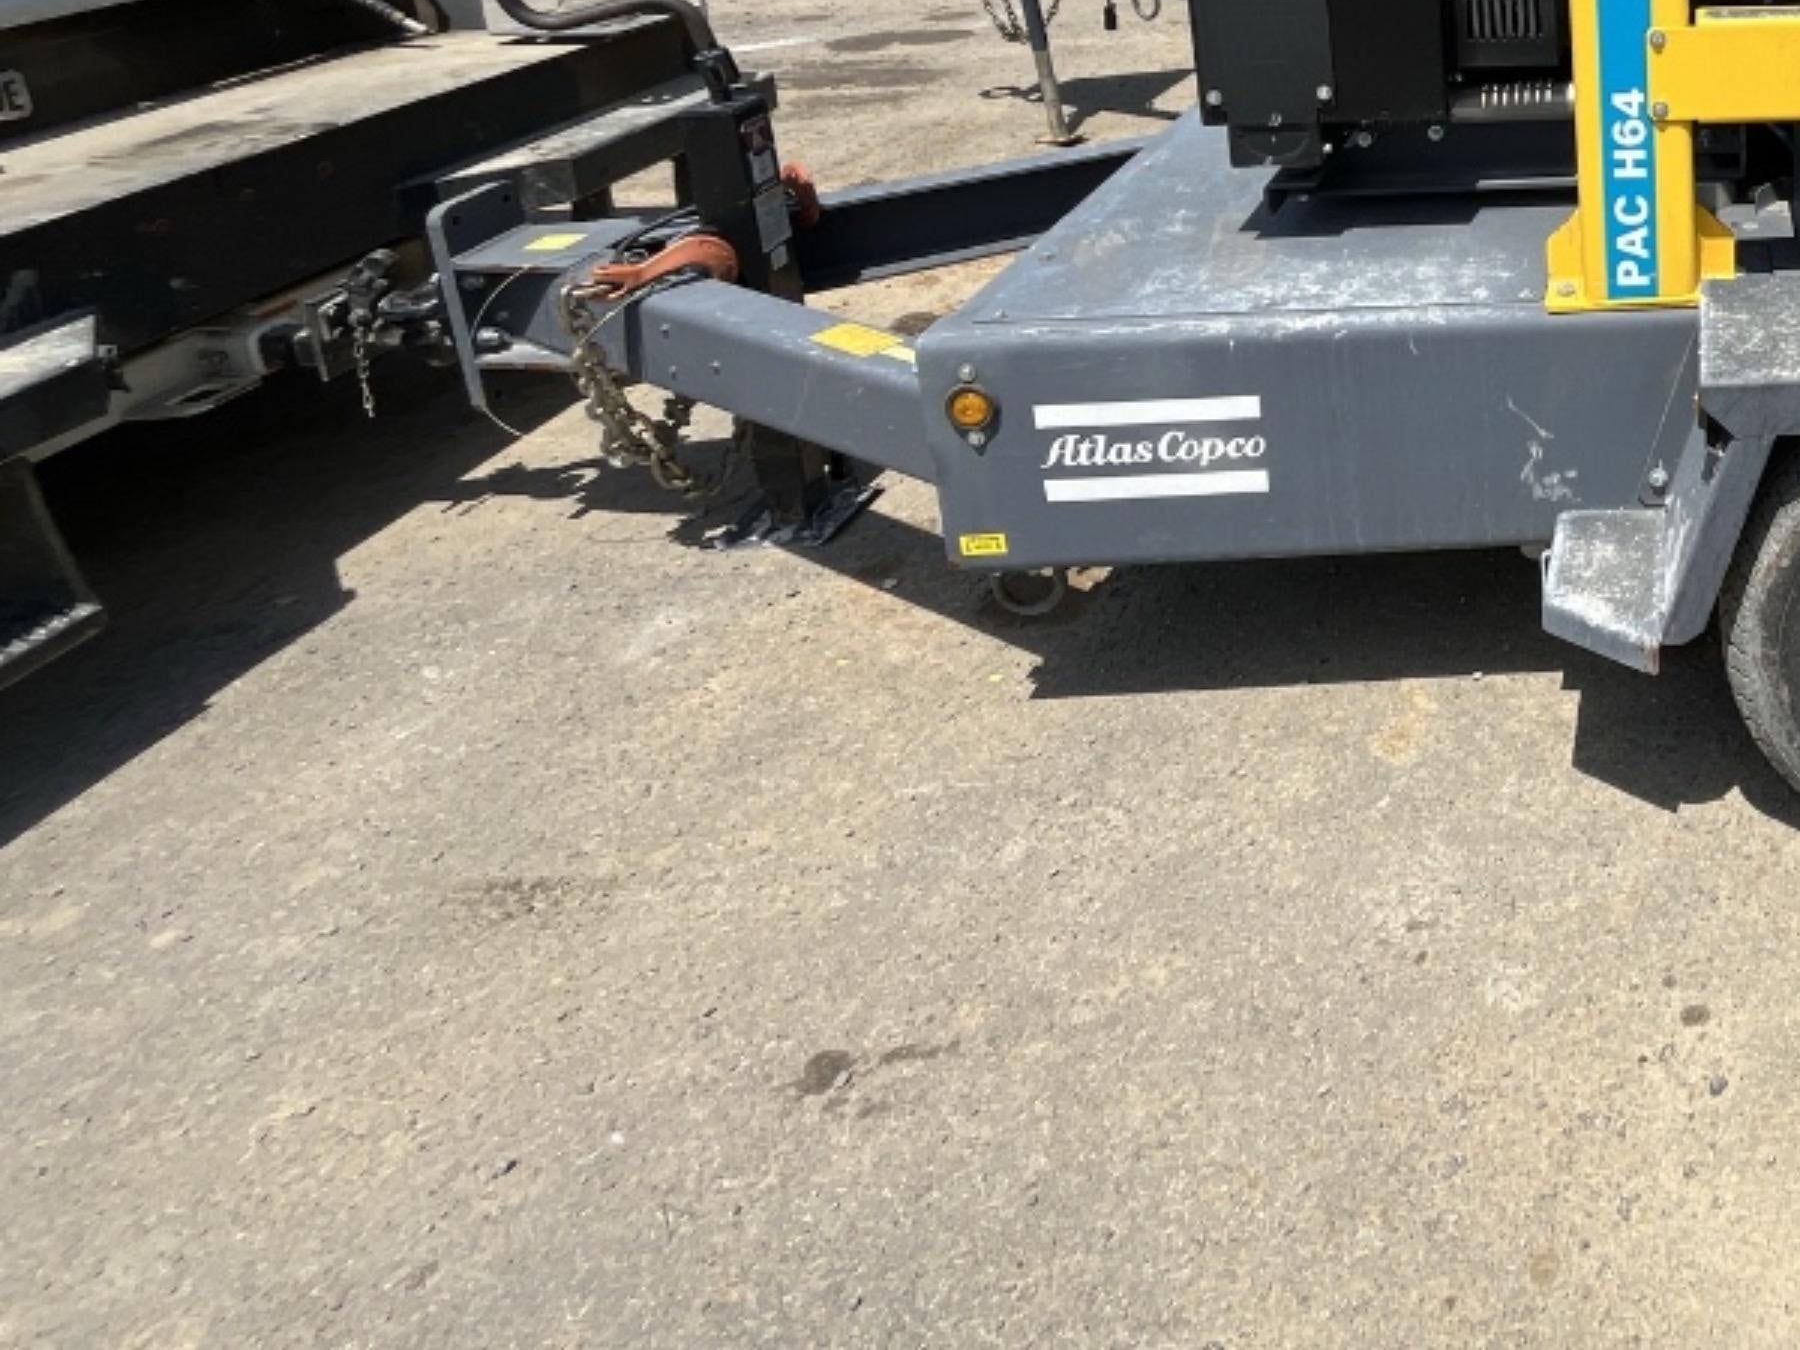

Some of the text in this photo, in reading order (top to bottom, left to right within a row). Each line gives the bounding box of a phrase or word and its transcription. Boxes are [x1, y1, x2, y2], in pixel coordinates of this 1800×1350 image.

[1610, 87, 1652, 288] PAC H64
[1040, 430, 1267, 470] Atlas Copco
